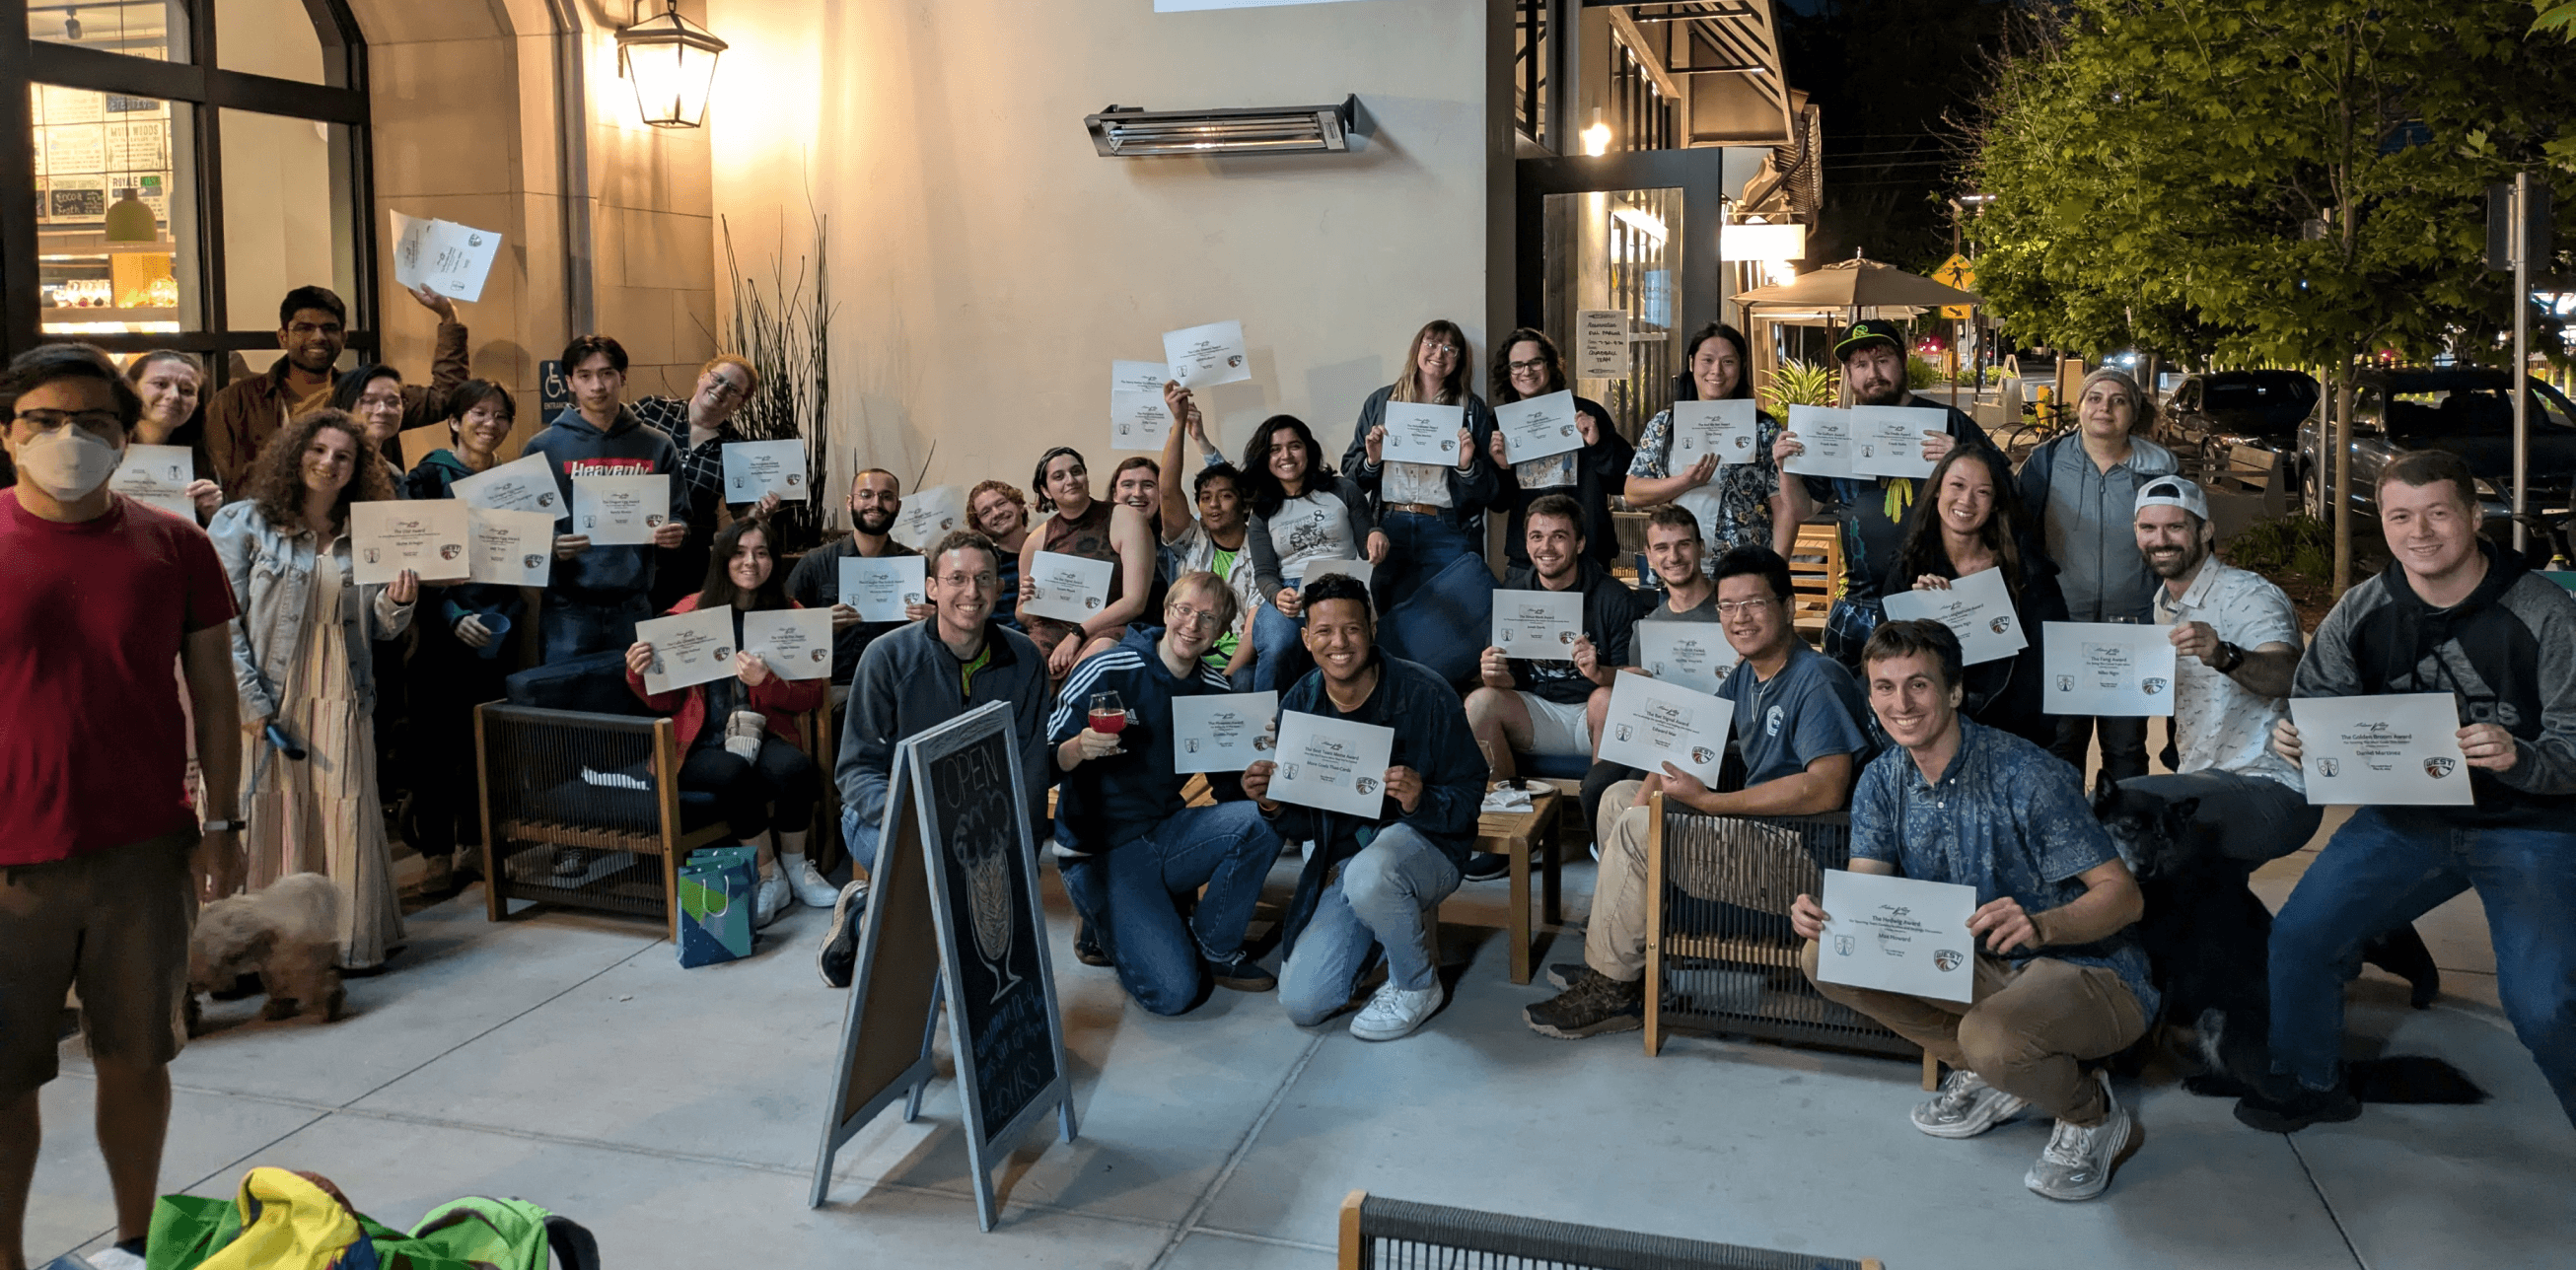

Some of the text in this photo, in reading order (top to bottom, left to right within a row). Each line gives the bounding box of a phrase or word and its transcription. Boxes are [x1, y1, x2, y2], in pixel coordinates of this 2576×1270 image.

[570, 460, 650, 479] Heavenly
[1314, 509, 1325, 522] 8
[943, 741, 1000, 809] OPEN
[1883, 916, 1902, 925] Hedwig
[1937, 951, 1961, 960] WEST
